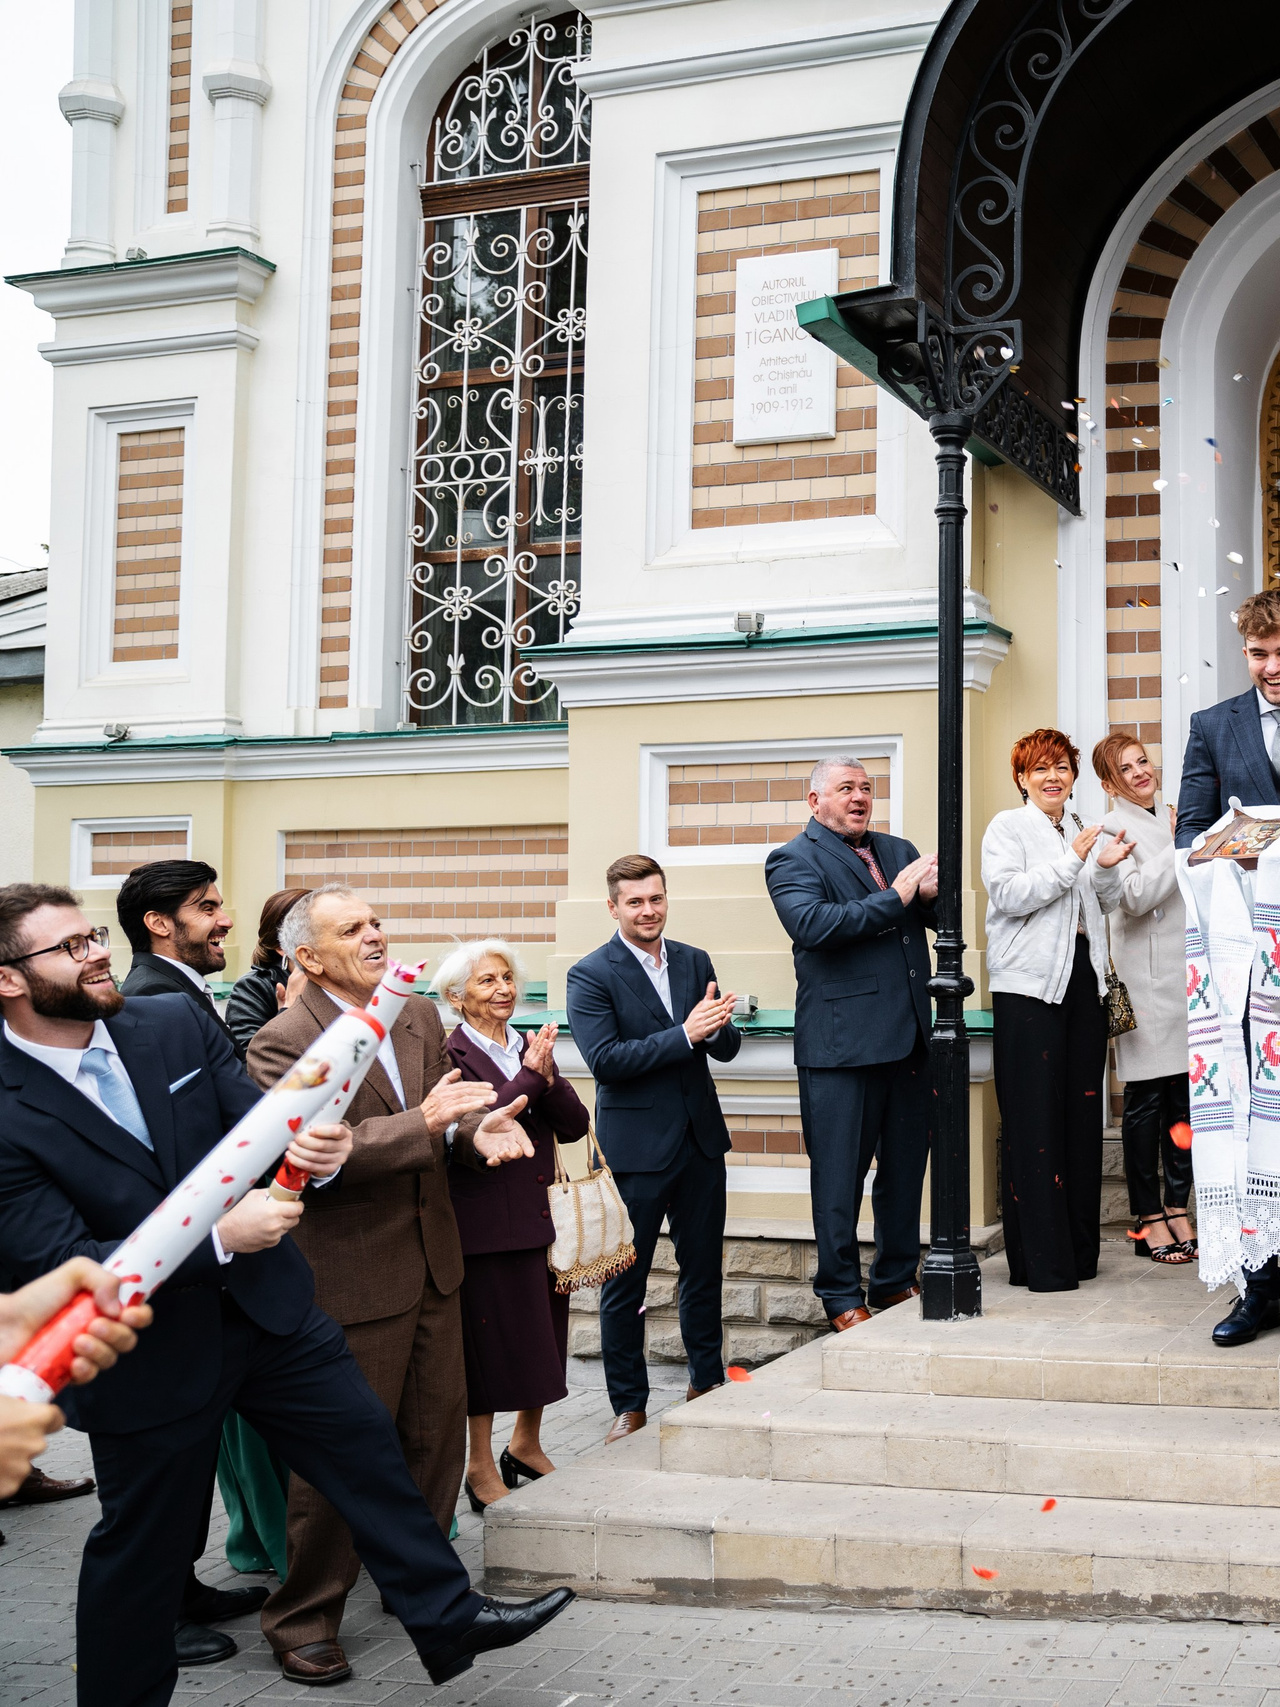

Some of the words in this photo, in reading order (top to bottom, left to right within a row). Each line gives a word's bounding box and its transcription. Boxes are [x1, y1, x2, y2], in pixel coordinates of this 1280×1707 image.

[761, 276, 807, 291] AUTORUL
[751, 290, 817, 307] OBIECTIVULUI
[759, 353, 807, 368] Arhitectul
[778, 384, 798, 395] anii
[751, 397, 814, 415] 1909-1912
